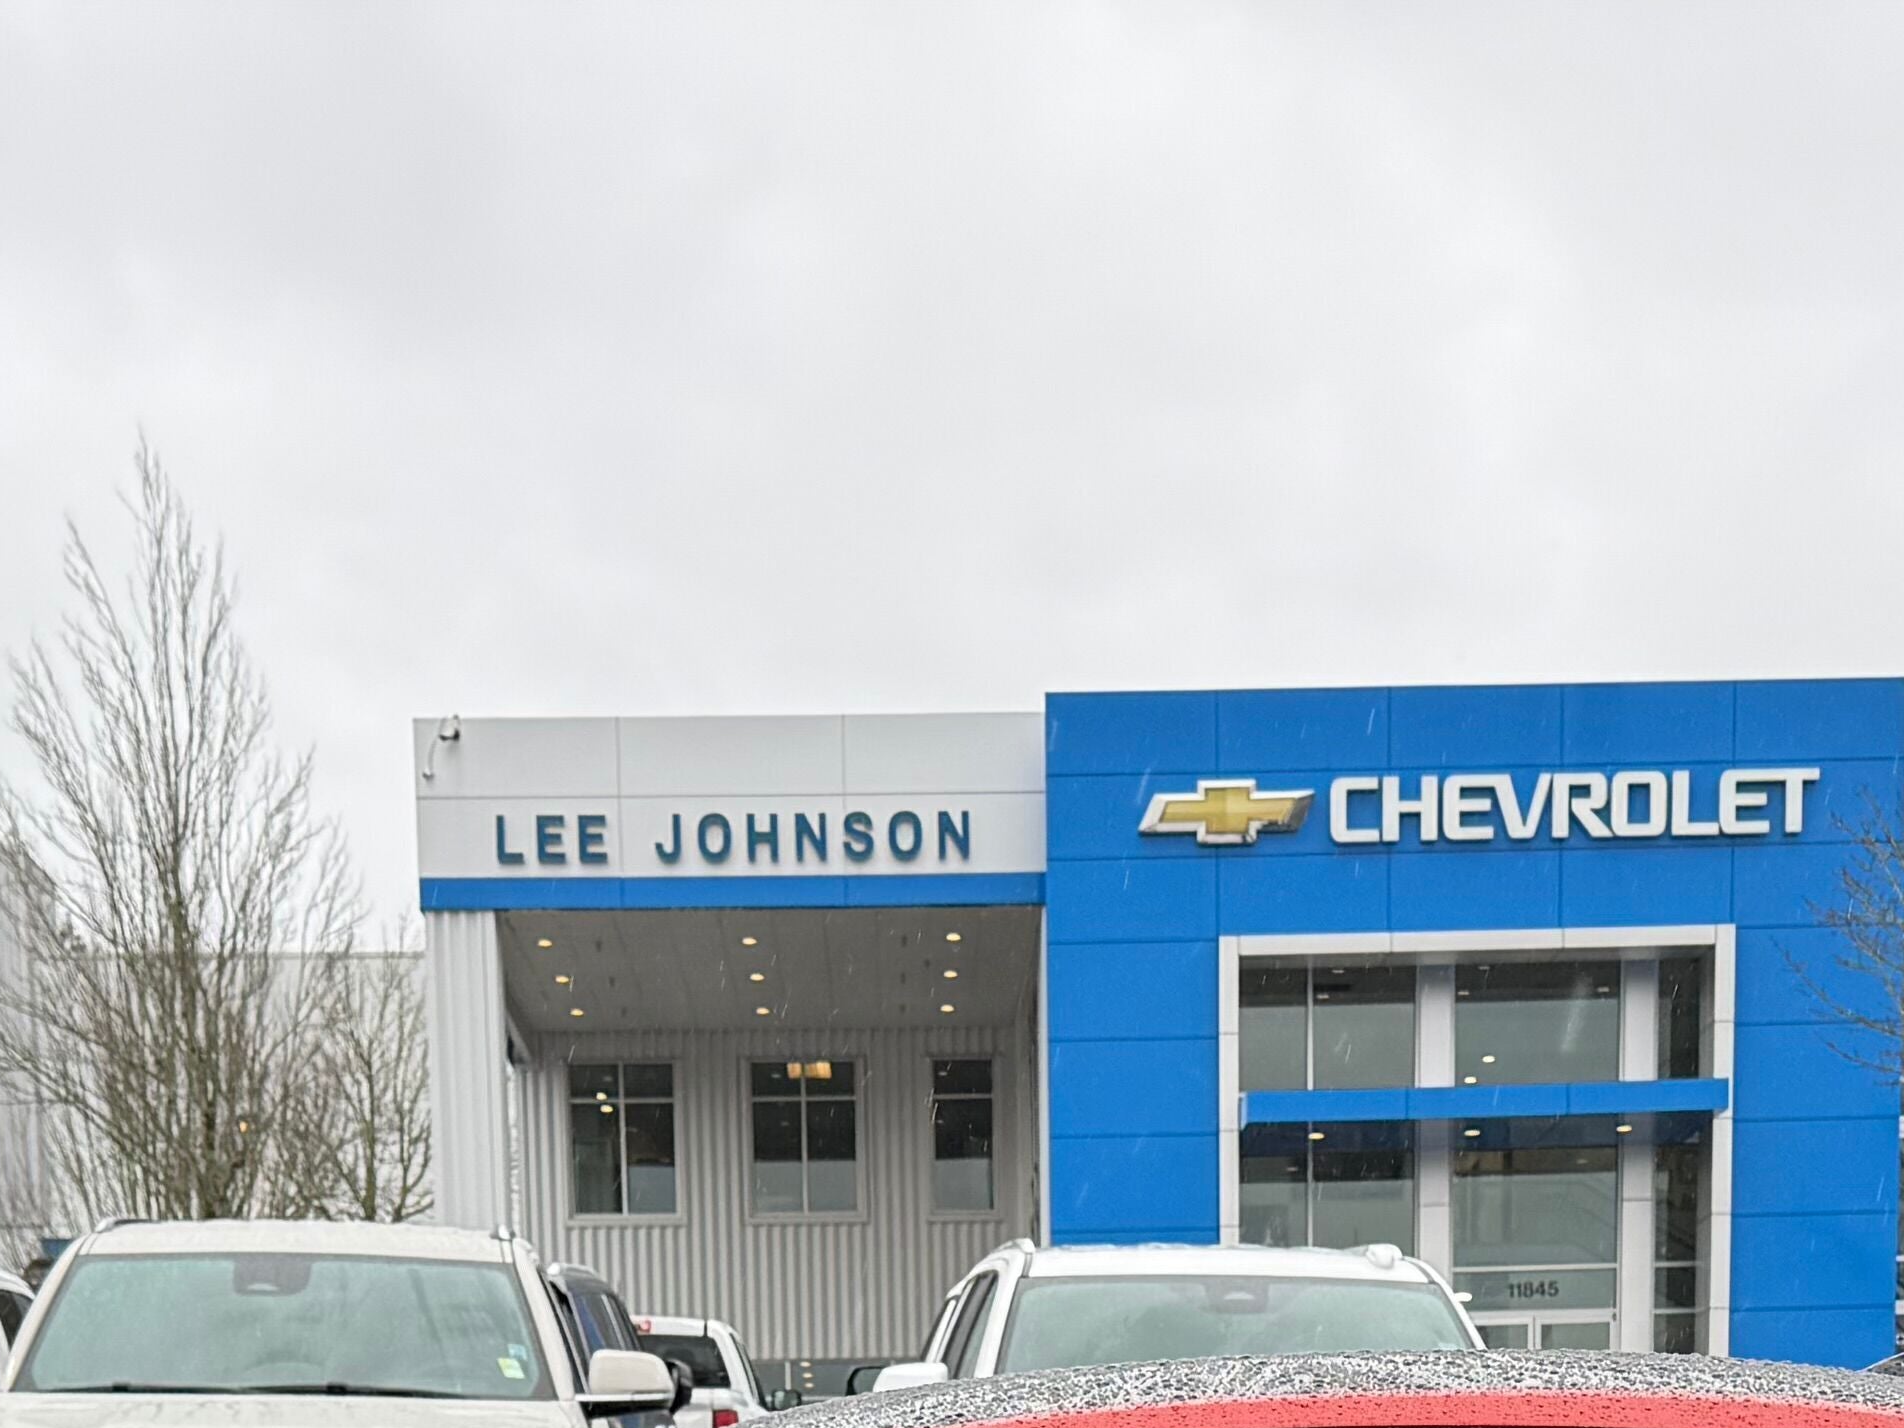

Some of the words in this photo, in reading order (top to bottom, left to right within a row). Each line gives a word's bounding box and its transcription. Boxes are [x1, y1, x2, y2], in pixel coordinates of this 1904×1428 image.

[1329, 767, 1820, 843] CHEVROLET
[496, 814, 608, 865] LEE
[654, 810, 971, 865] JOHNSON
[1507, 1280, 1560, 1299] 11845
